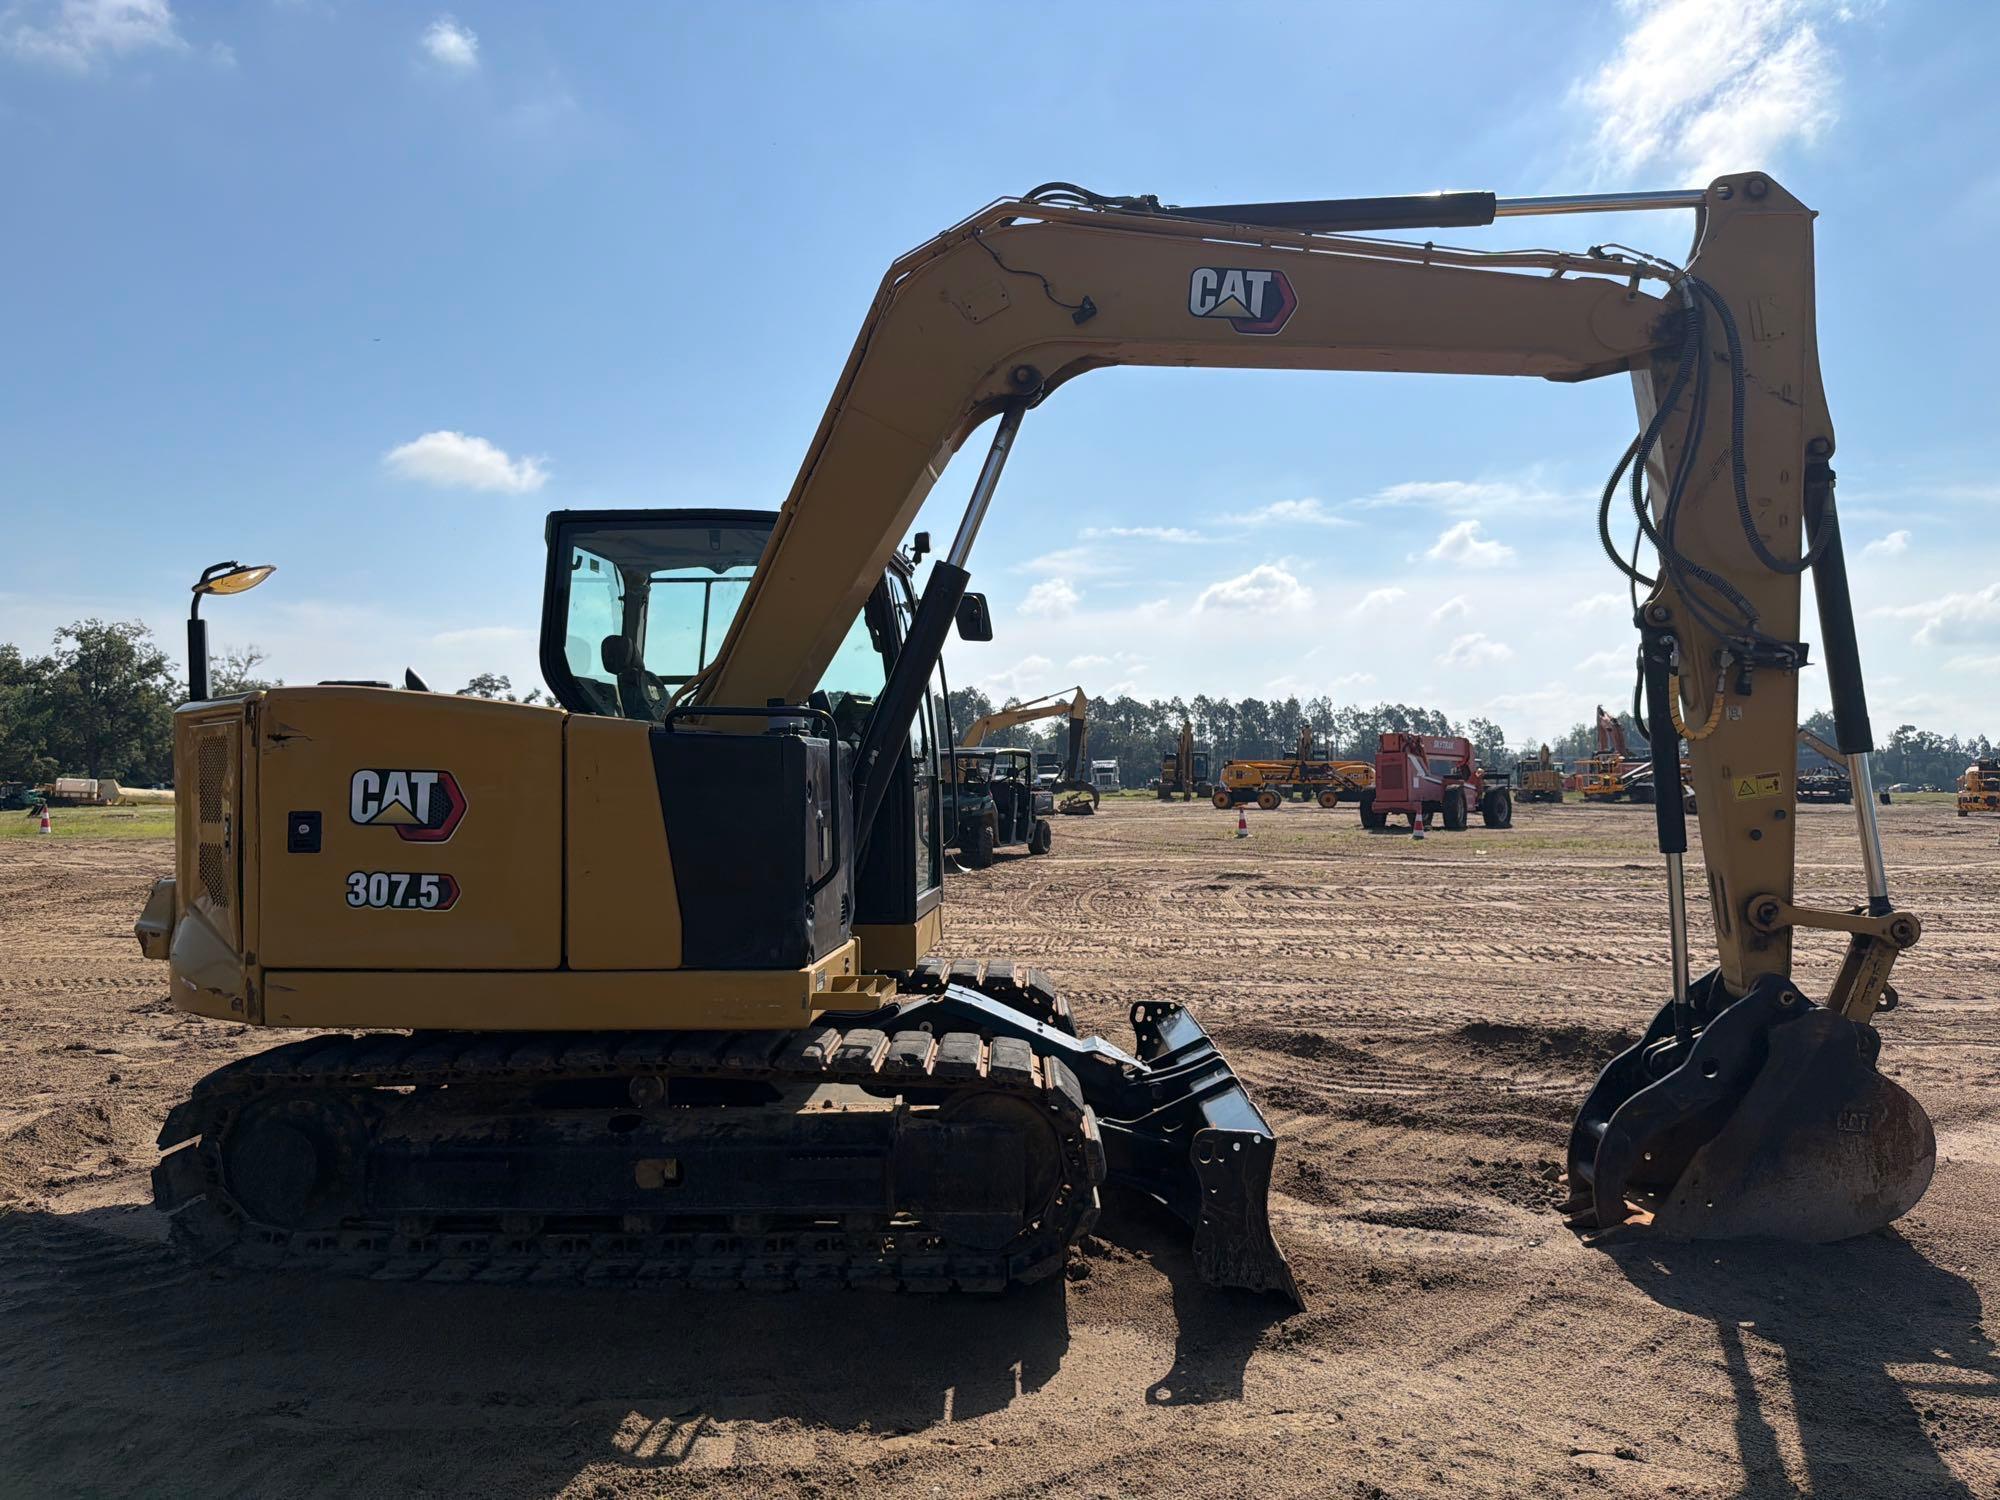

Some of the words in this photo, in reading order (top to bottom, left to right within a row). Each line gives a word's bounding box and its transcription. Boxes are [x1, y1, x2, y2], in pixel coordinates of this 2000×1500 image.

[1190, 268, 1271, 318] CAT
[351, 769, 438, 824] CAT
[347, 872, 439, 908] 307.5
